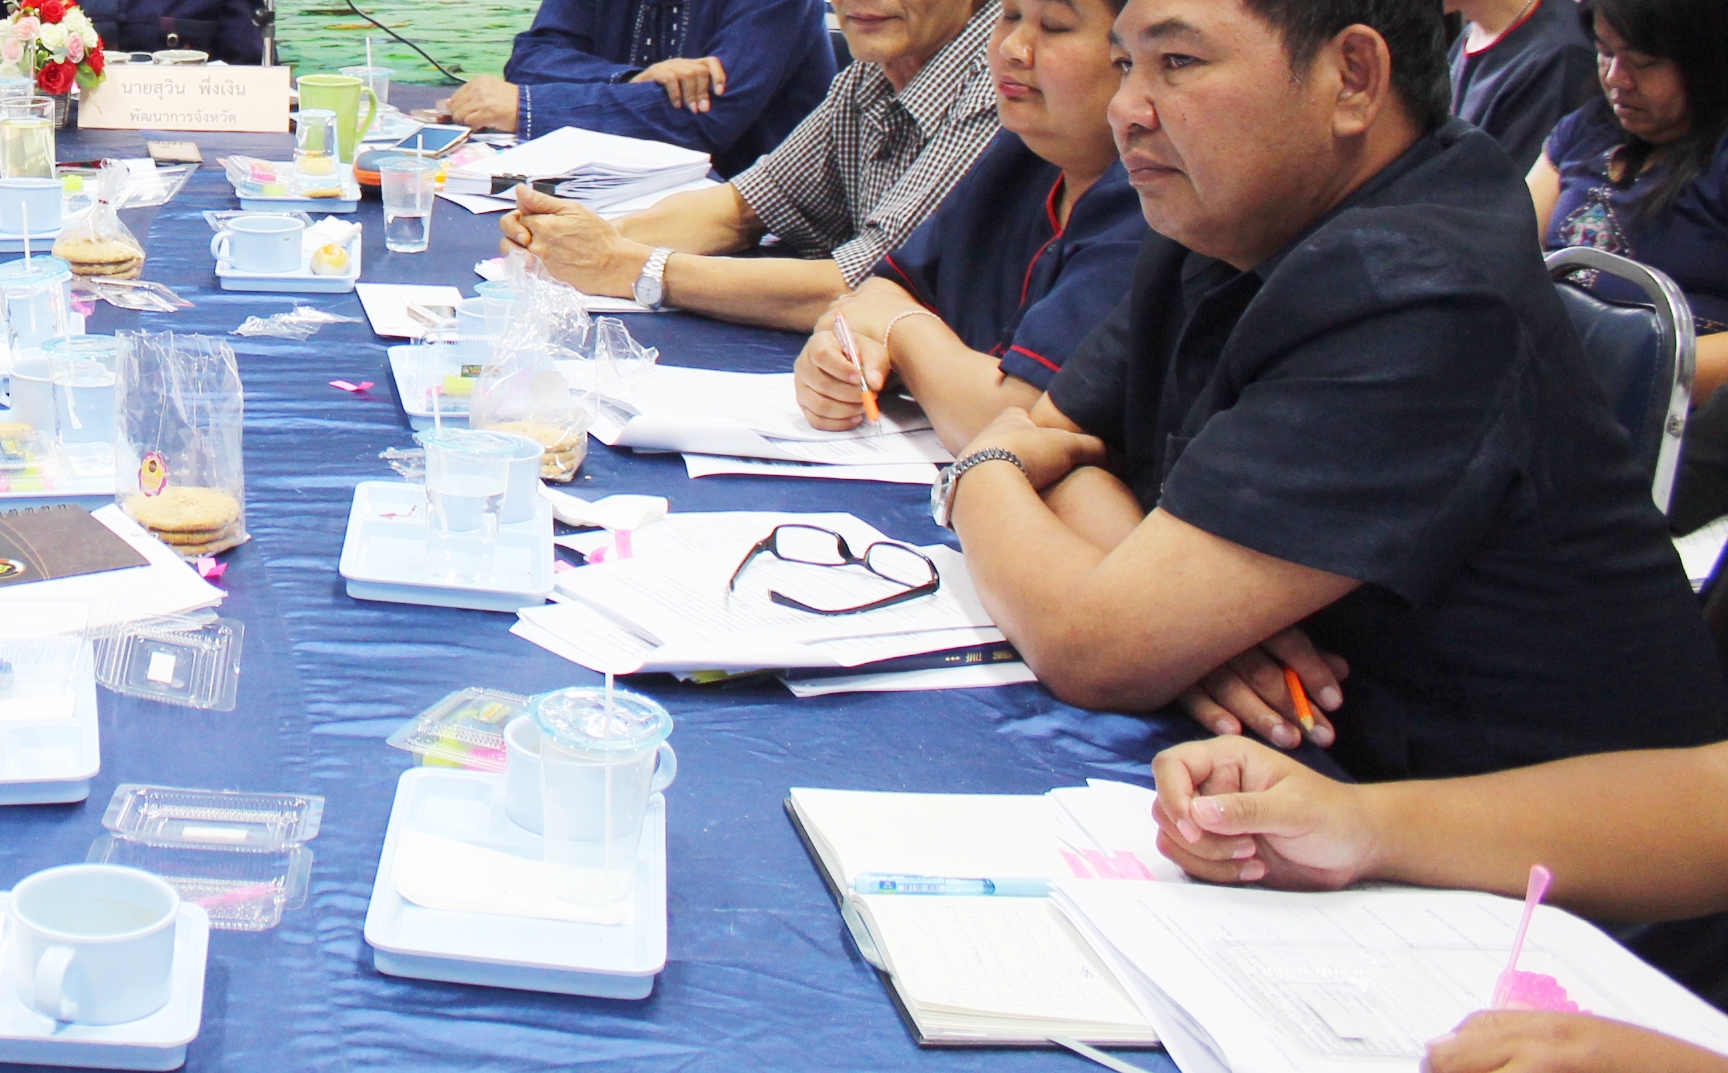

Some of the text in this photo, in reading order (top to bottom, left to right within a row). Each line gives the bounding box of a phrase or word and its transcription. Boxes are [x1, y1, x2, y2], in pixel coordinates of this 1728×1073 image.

[121, 79, 186, 100] นายสุวิน
[129, 107, 237, 124] พัฒนาการจังหวัด
